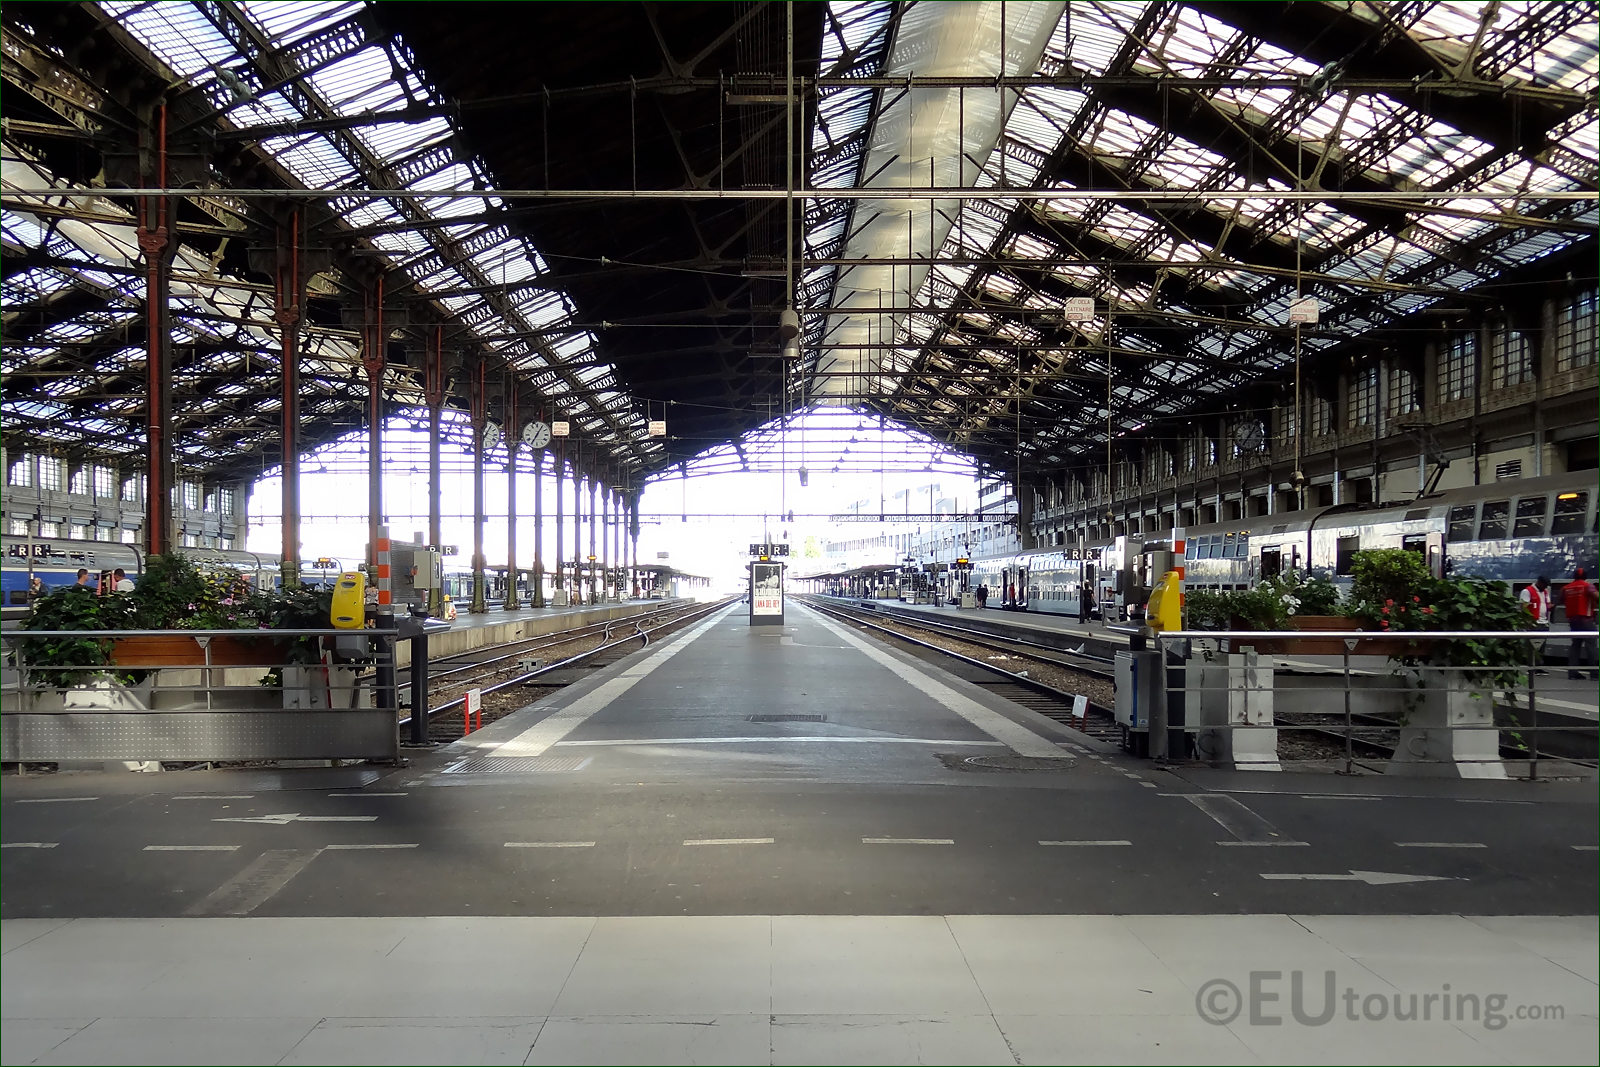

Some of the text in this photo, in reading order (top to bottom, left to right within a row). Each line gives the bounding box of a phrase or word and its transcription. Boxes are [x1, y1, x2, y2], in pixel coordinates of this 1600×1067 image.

[18, 546, 26, 556] R
[34, 546, 42, 556] R
[445, 546, 452, 555] R
[758, 546, 765, 555] R
[774, 546, 781, 555] R
[1072, 550, 1079, 560] R
[1086, 550, 1093, 560] R
[755, 599, 765, 608] LANA
